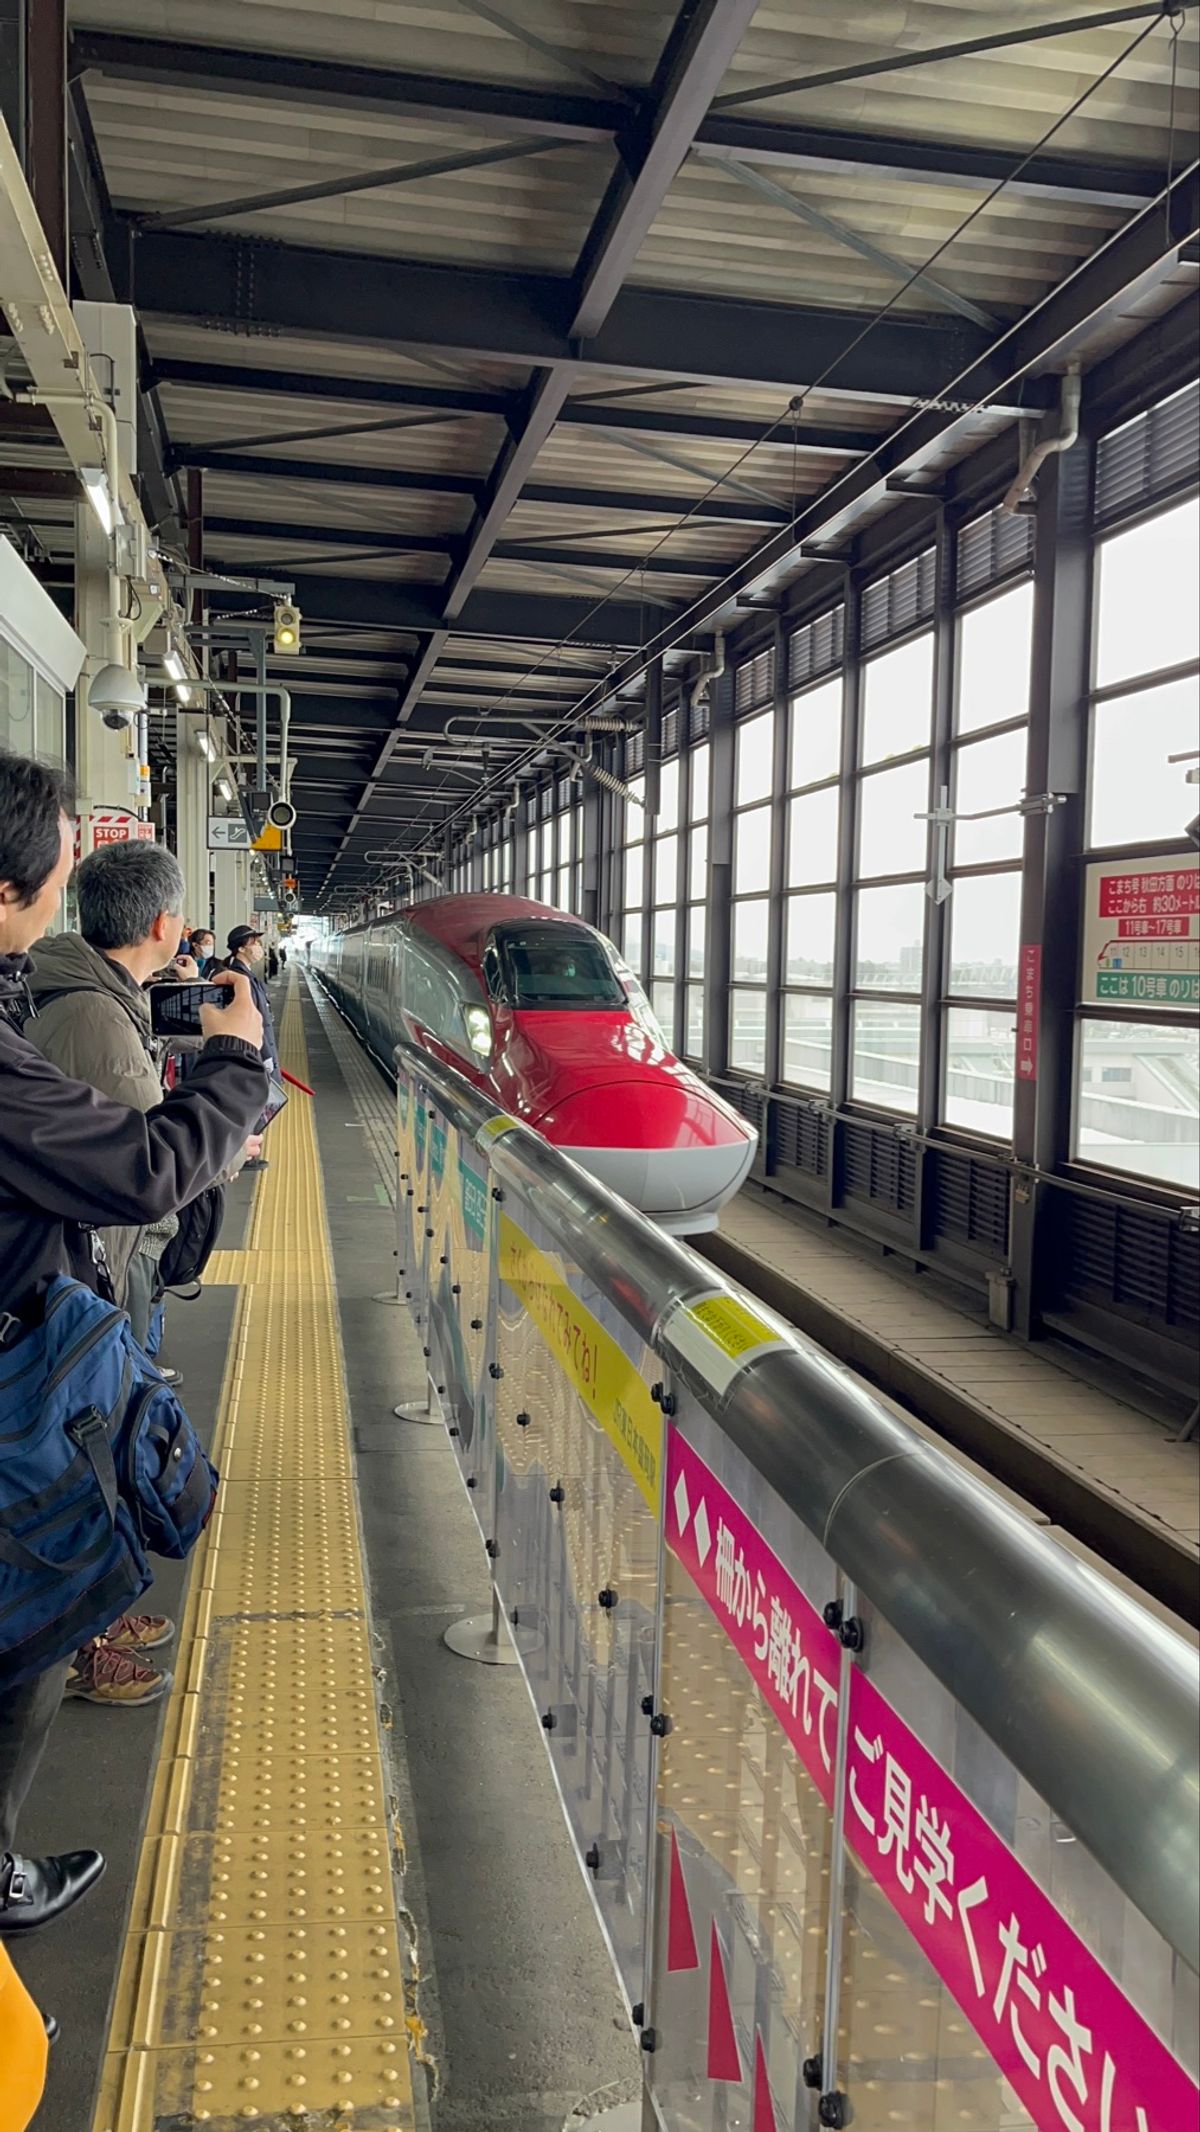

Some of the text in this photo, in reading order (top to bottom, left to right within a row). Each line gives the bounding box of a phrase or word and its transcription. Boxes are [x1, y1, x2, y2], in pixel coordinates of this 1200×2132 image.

[96, 828, 127, 839] STOP
[715, 1516, 838, 1774] 柵から離れて
